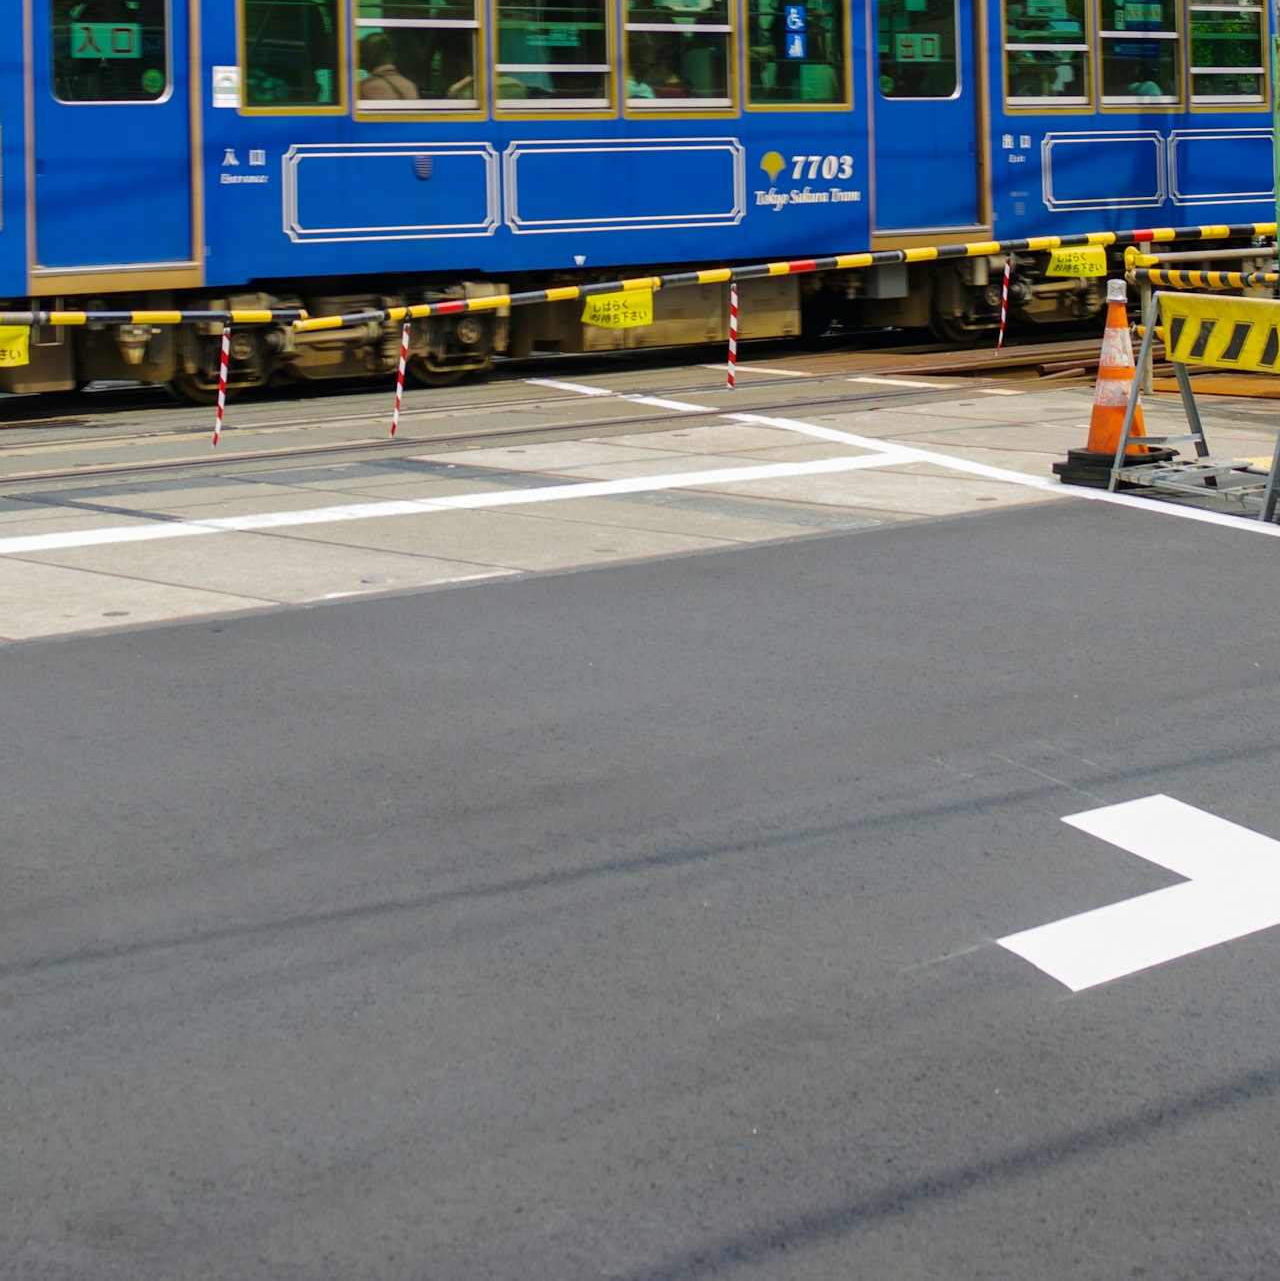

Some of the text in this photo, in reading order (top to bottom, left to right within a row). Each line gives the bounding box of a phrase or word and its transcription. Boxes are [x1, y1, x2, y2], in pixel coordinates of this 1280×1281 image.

[76, 26, 135, 54] 入口
[900, 36, 937, 58] 出口
[1002, 133, 1031, 149] 出口
[221, 148, 266, 166] 入口
[791, 155, 854, 179] 7703
[754, 186, 861, 211] Tokyo Sakura Tram
[1057, 252, 1087, 262] しばらく
[1053, 263, 1103, 273] お待ち下さい
[593, 300, 629, 312] しばらく
[589, 310, 648, 324] お待ち下さい
